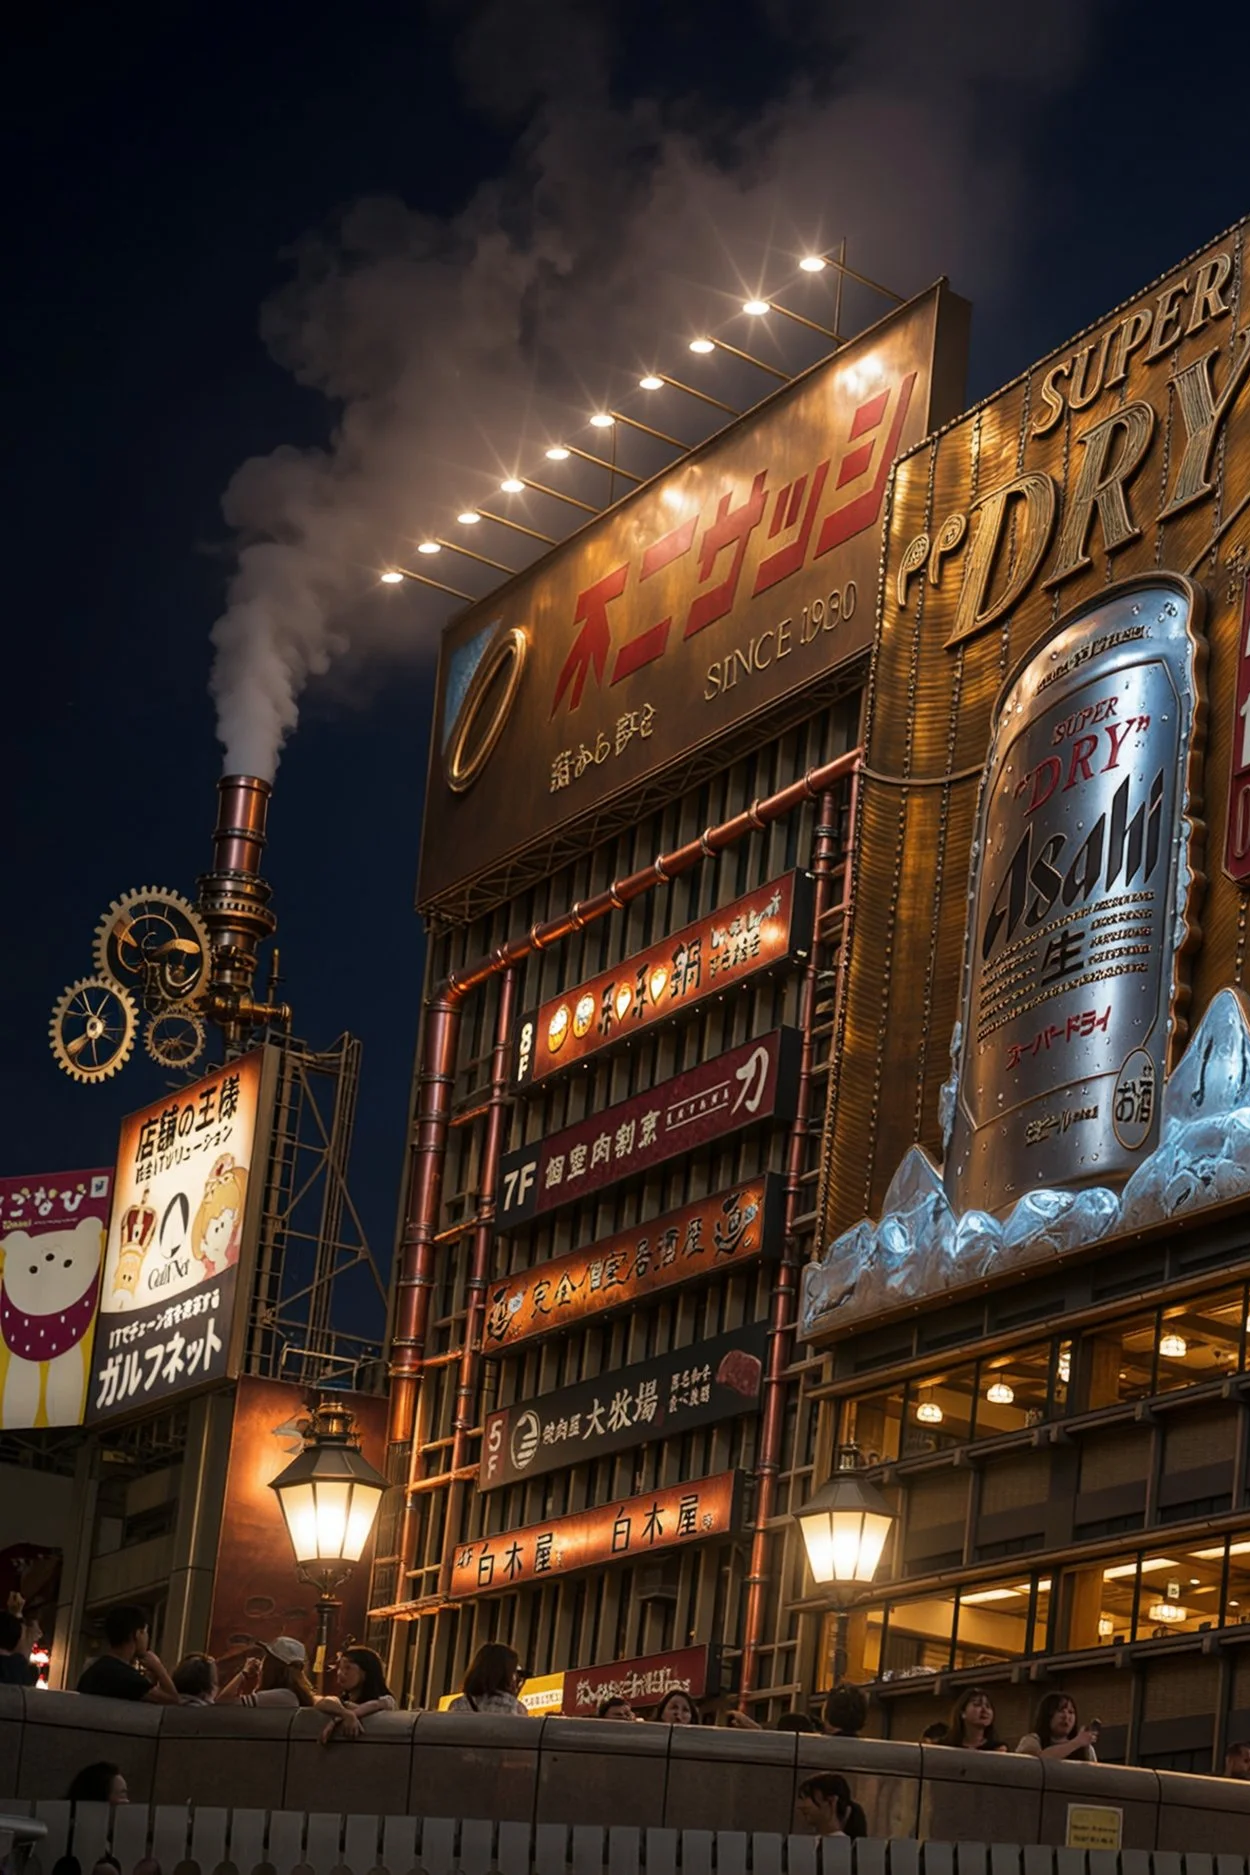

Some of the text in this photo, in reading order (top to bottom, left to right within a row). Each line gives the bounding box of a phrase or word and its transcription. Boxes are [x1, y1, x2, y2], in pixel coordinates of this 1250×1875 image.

[1031, 253, 1232, 437] SUPER
[704, 617, 793, 701] SINCE
[1051, 696, 1118, 746] SUPER
[983, 768, 1165, 960] Asahi
[1041, 930, 1086, 986] 生
[503, 1161, 537, 1212] 7F
[96, 1317, 222, 1409] ガルフネット
[611, 1494, 699, 1553] 白木屋
[477, 1532, 553, 1587] 白木屋
